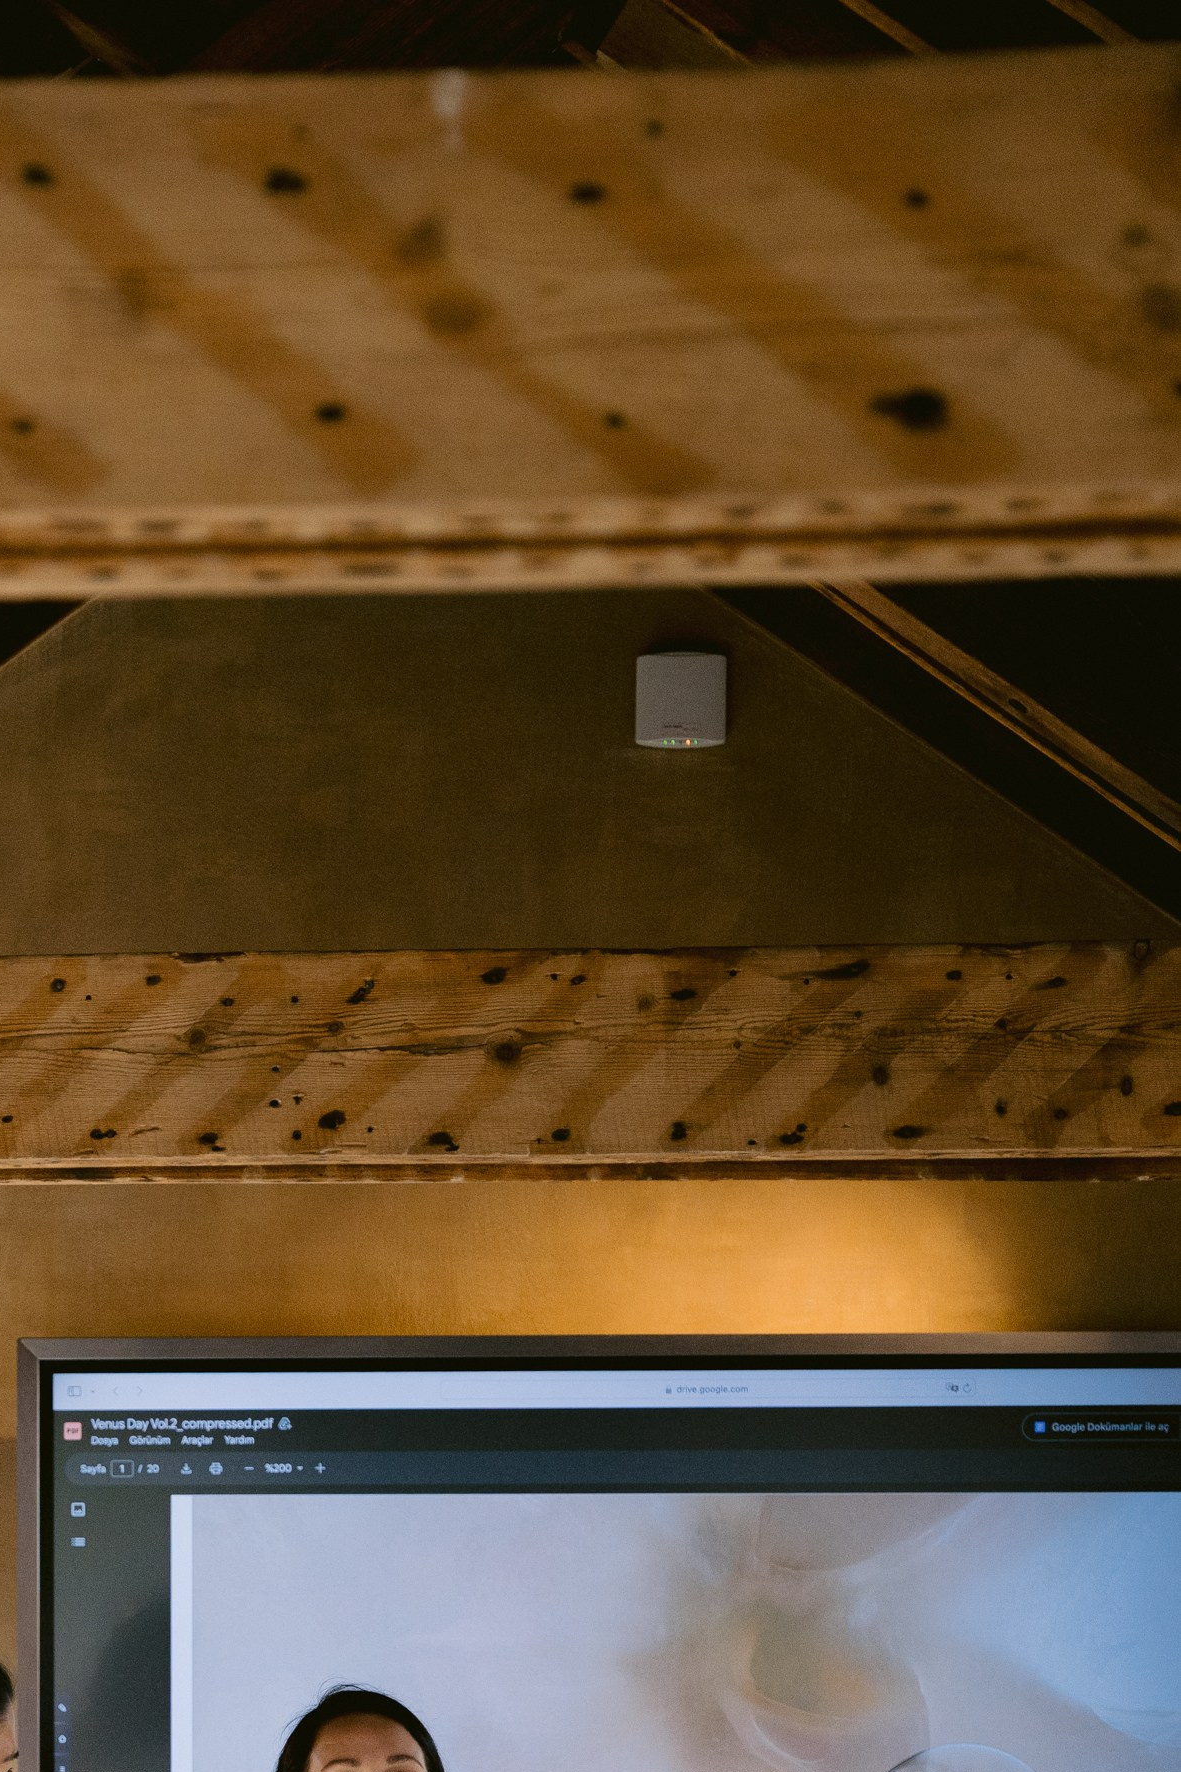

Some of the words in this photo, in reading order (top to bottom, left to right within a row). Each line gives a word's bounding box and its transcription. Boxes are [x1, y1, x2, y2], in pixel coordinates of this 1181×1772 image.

[676, 1384, 749, 1394] drive.google.com
[90, 1418, 126, 1430] Venus
[127, 1418, 149, 1432] Day
[150, 1417, 274, 1432] Vol.2_compressed.pdf
[1051, 1422, 1085, 1433] Google
[1087, 1421, 1142, 1431] Dokümanlar
[1145, 1422, 1156, 1431] ile
[1158, 1424, 1169, 1433] aç
[90, 1436, 119, 1447] Dosya
[129, 1435, 171, 1445] Görünüm
[80, 1463, 107, 1475] Sayfa
[119, 1464, 125, 1473] 1
[146, 1463, 160, 1473] 20
